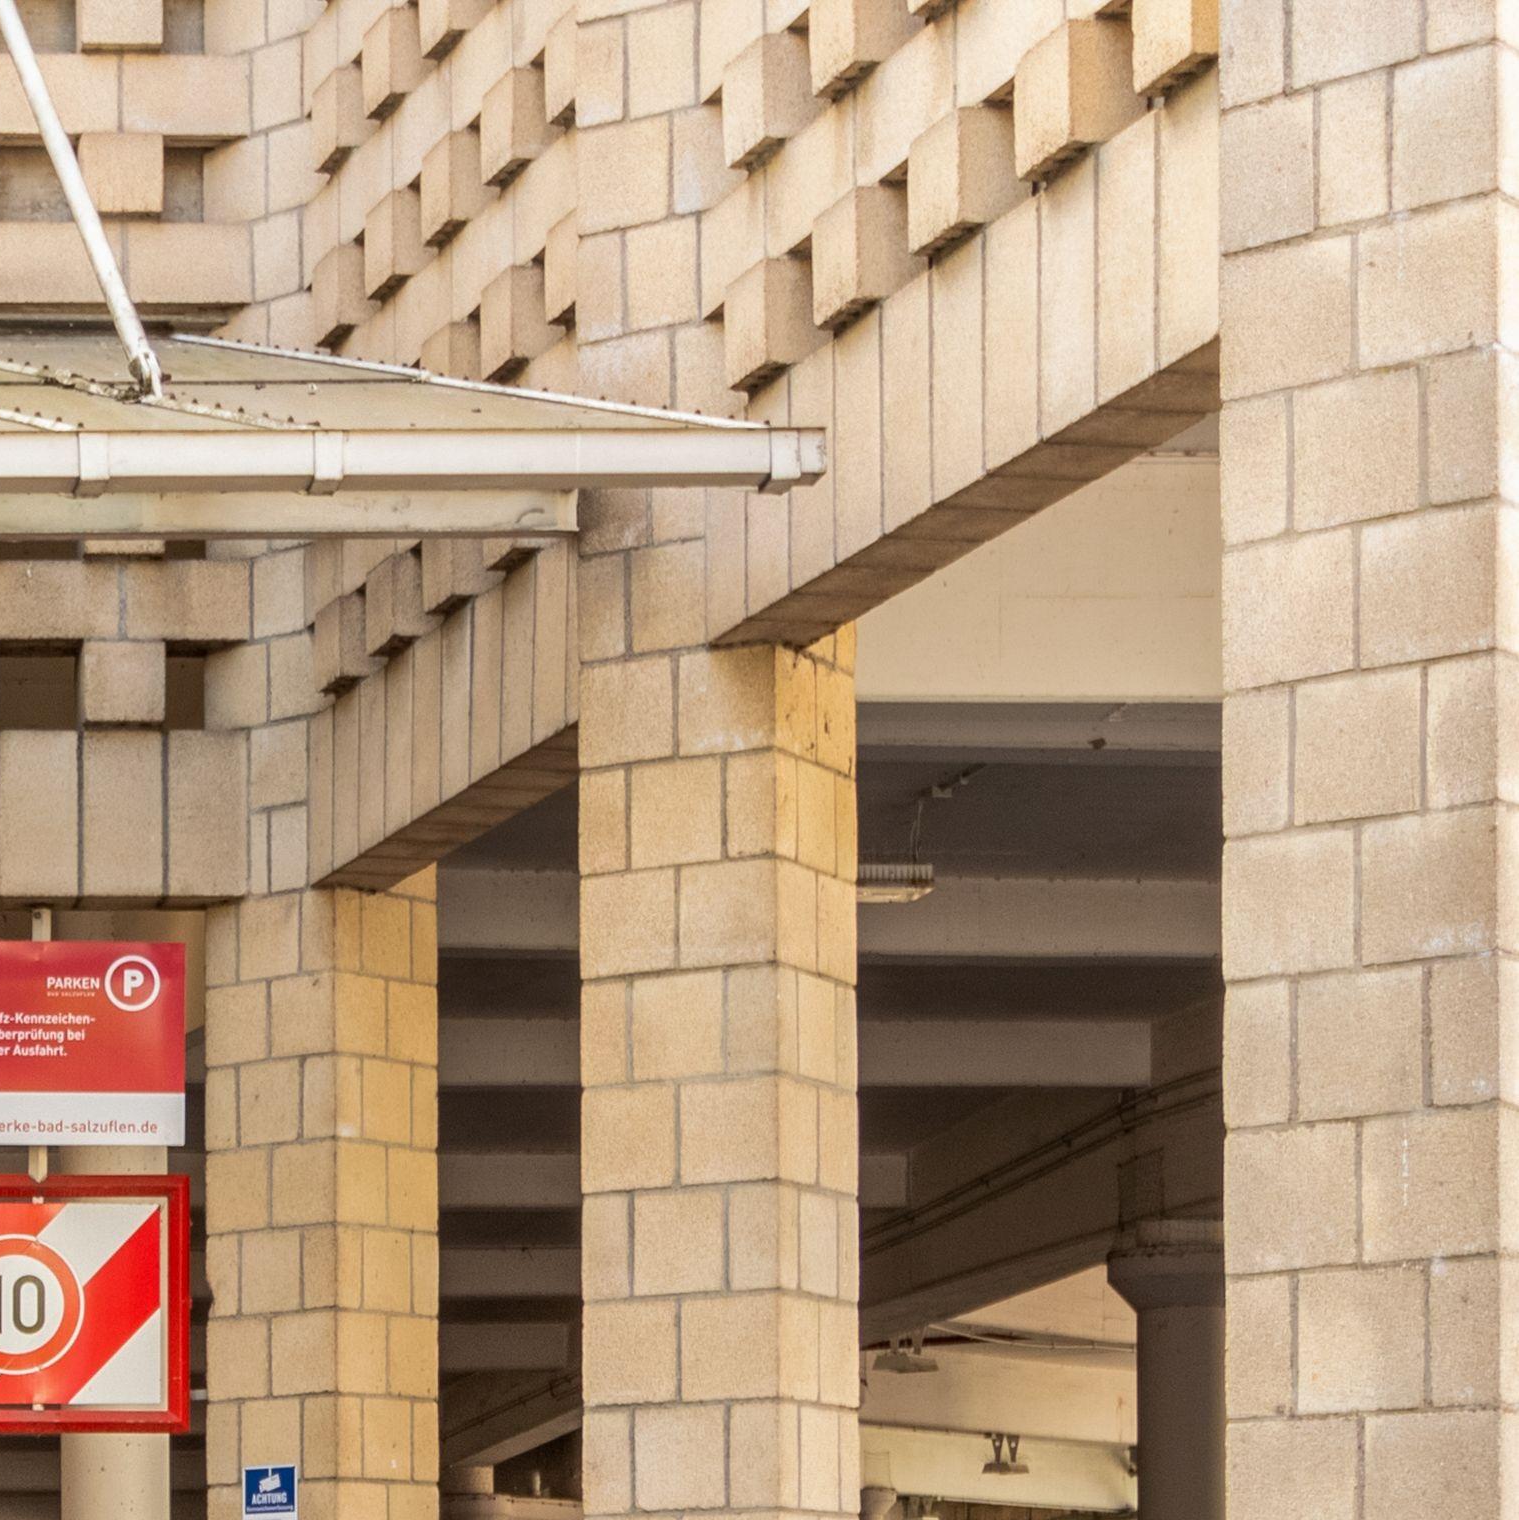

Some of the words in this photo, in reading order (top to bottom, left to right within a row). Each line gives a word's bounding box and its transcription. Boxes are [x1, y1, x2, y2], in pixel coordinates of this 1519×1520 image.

[46, 976, 100, 989] PARKEN
[123, 969, 144, 997] P
[67, 1029, 85, 1041] bei
[13, 1045, 67, 1057] Ausfahrt.
[251, 1492, 288, 1505] ACHTUNG
